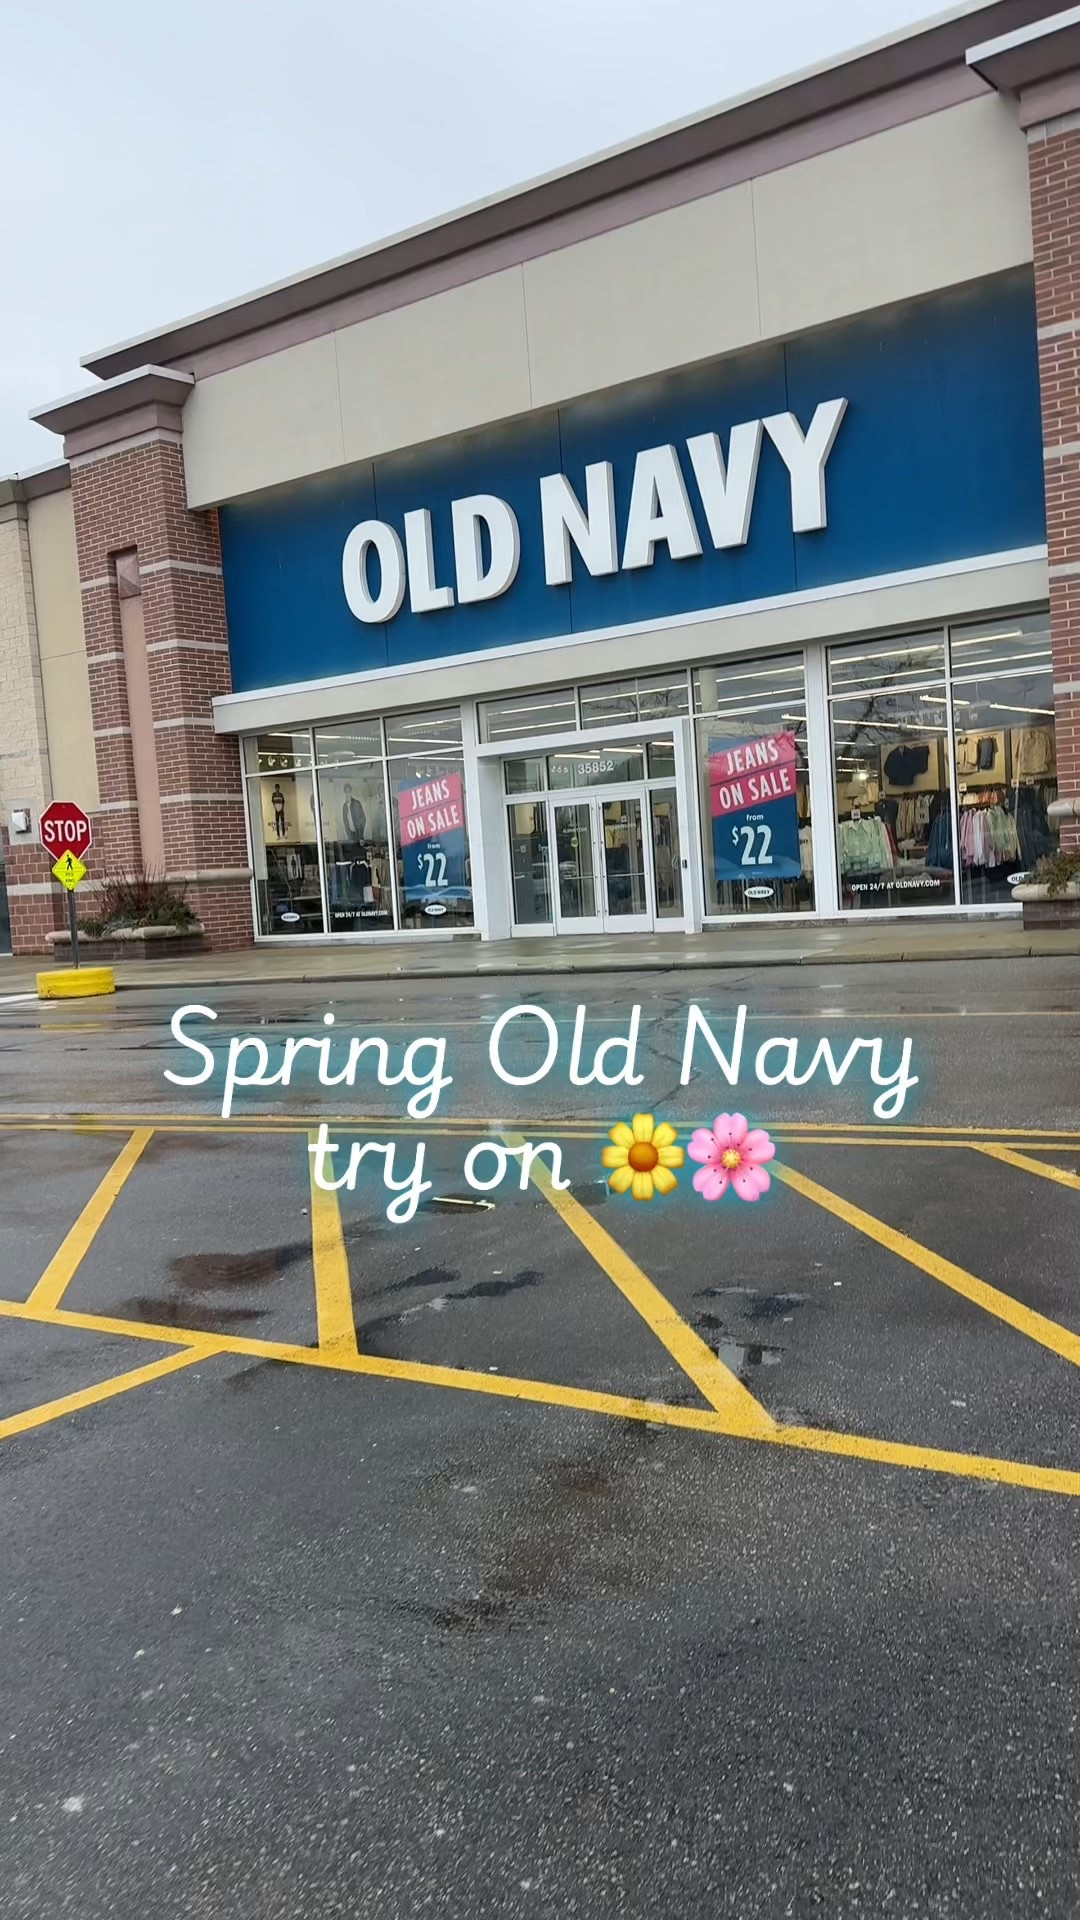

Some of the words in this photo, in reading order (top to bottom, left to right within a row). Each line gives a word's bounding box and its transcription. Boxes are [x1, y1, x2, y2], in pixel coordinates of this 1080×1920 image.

[342, 494, 520, 623] OLD
[540, 397, 848, 586] NAVY
[577, 760, 614, 775] 35852
[727, 738, 779, 775] JEANS
[411, 779, 450, 810] JEANS
[719, 782, 744, 809] ON
[748, 768, 792, 801] SALE
[44, 820, 87, 842] STOP
[407, 816, 426, 839] ON
[428, 804, 460, 832] SALE
[732, 825, 773, 865] $22
[417, 852, 449, 887] $22
[869, 882, 885, 891] 24/7
[886, 881, 894, 889] AT
[895, 879, 940, 889] OLDNAVY.COM
